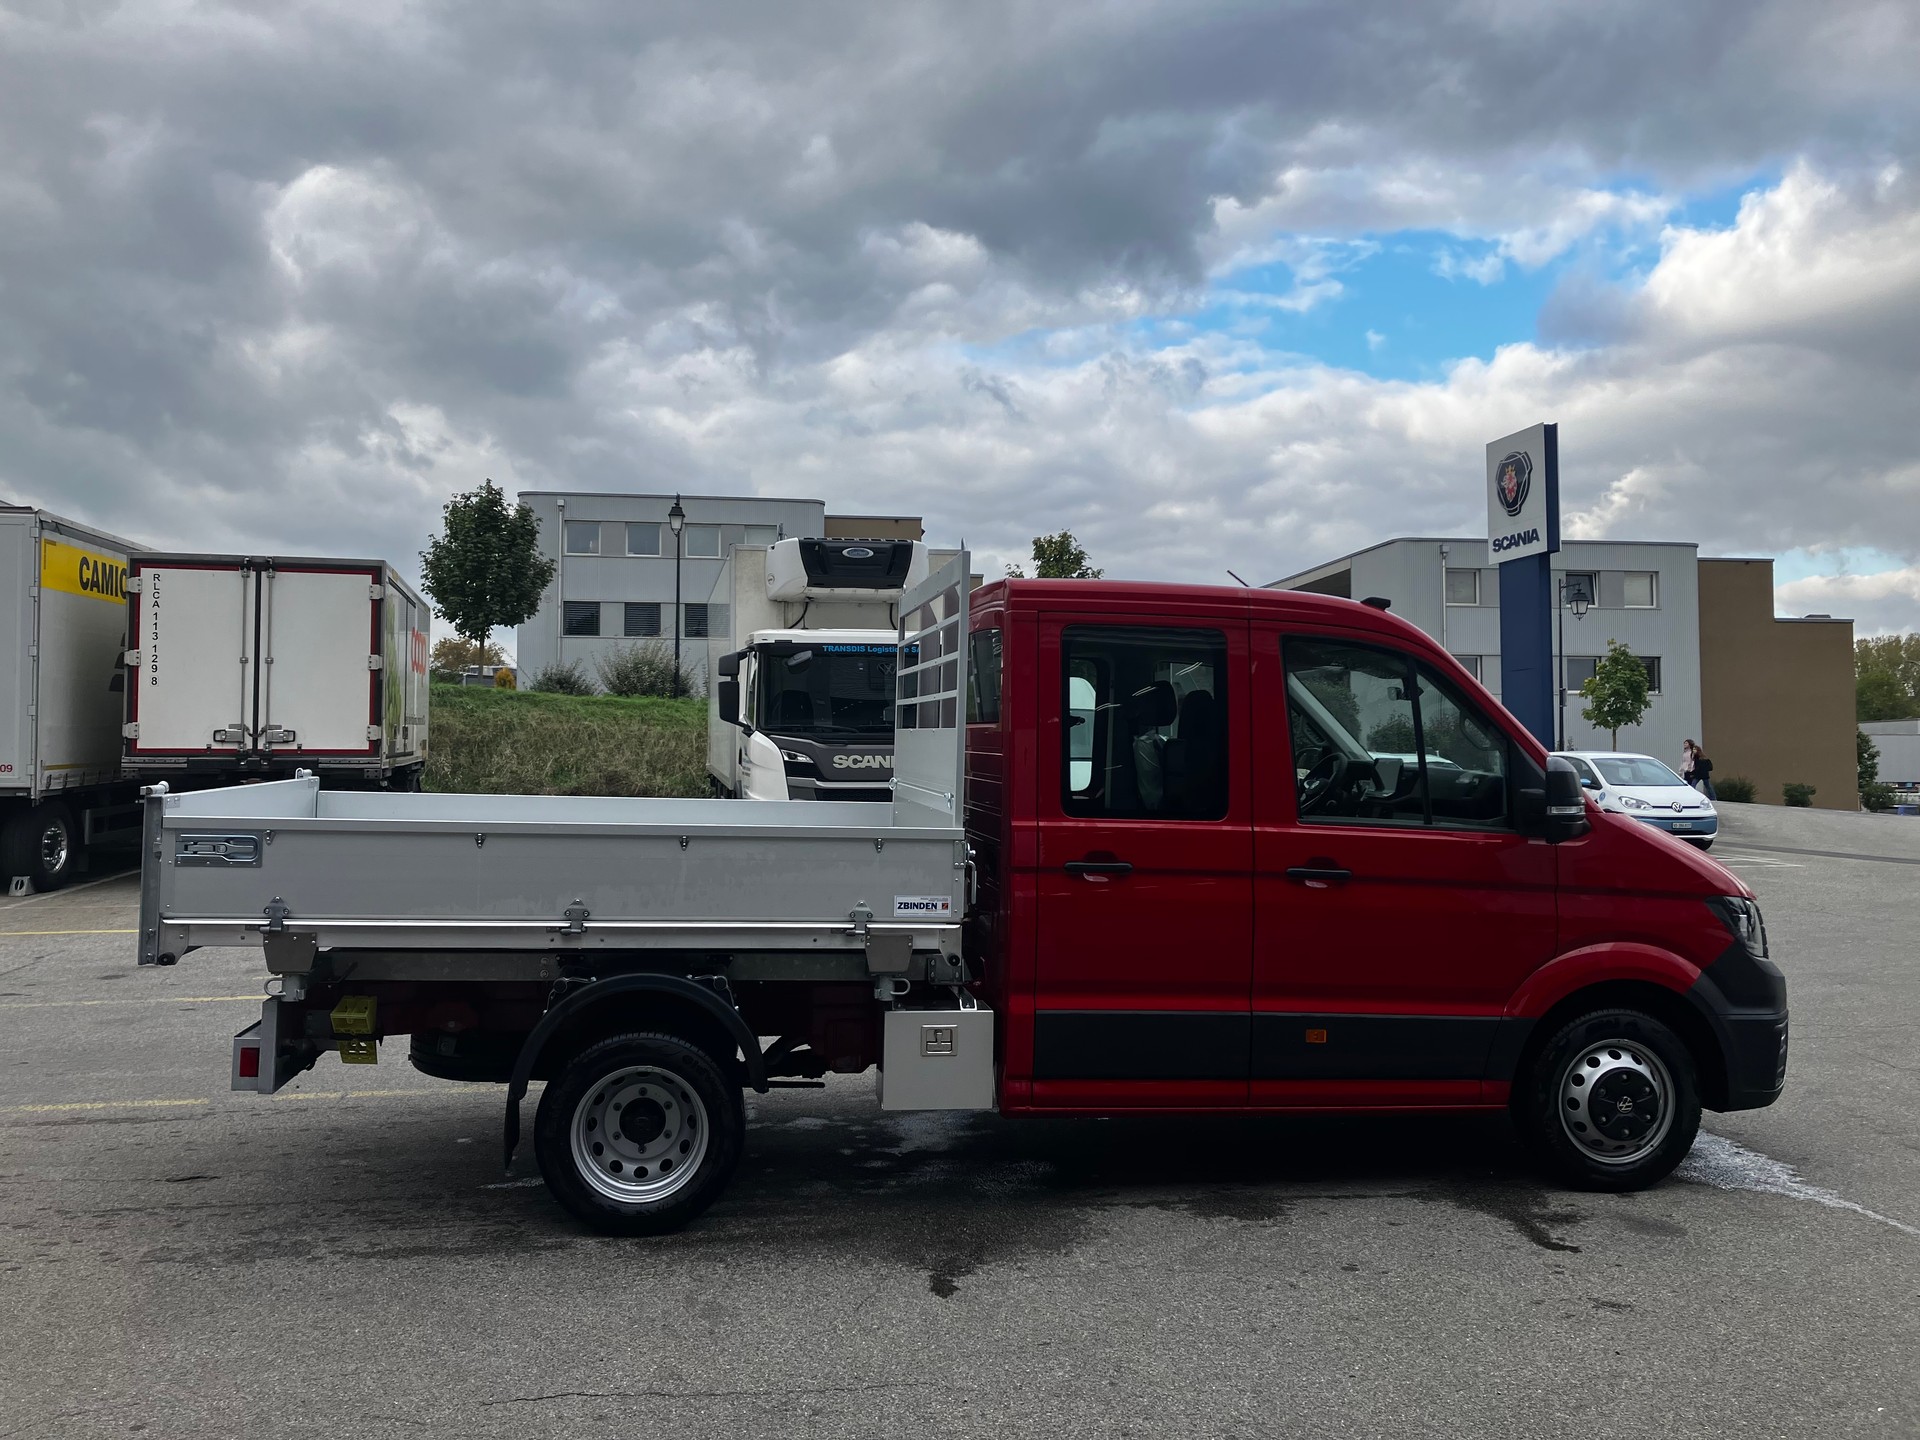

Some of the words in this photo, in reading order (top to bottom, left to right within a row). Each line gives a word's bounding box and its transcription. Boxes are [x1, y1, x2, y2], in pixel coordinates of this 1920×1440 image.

[1493, 528, 1540, 552] SCANIA
[152, 573, 160, 608] RLCA
[867, 645, 909, 654] Logistie
